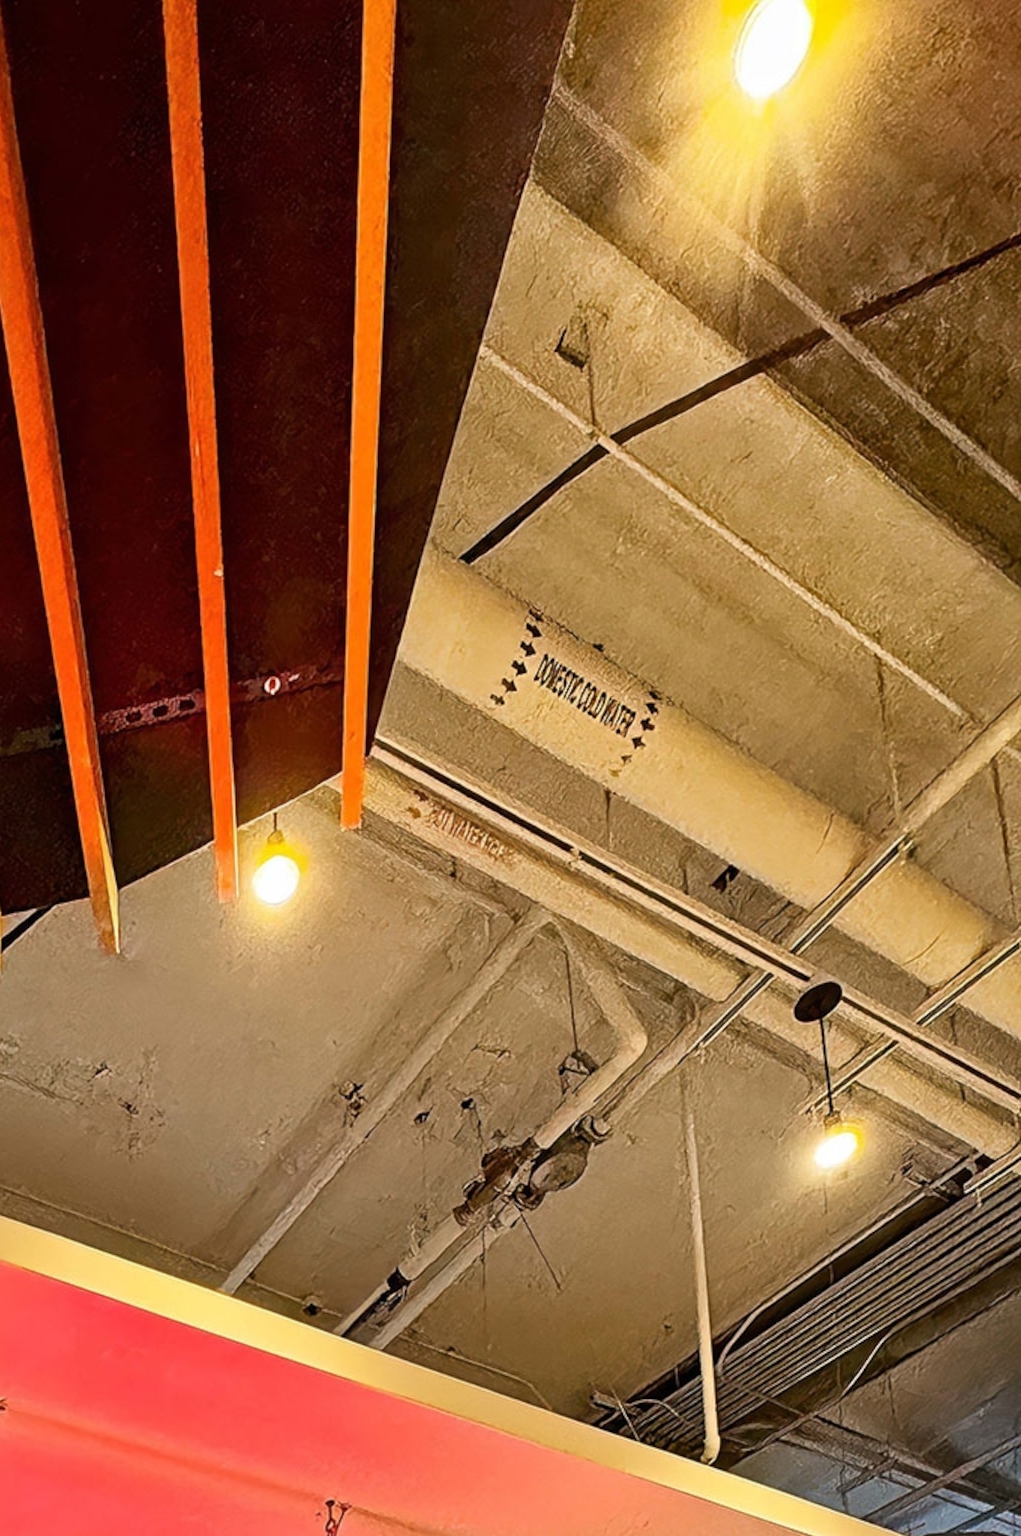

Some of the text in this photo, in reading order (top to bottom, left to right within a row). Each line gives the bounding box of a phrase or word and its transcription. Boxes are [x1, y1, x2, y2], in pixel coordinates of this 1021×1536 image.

[533, 653, 637, 738] DOMESTIC COLD WATER
